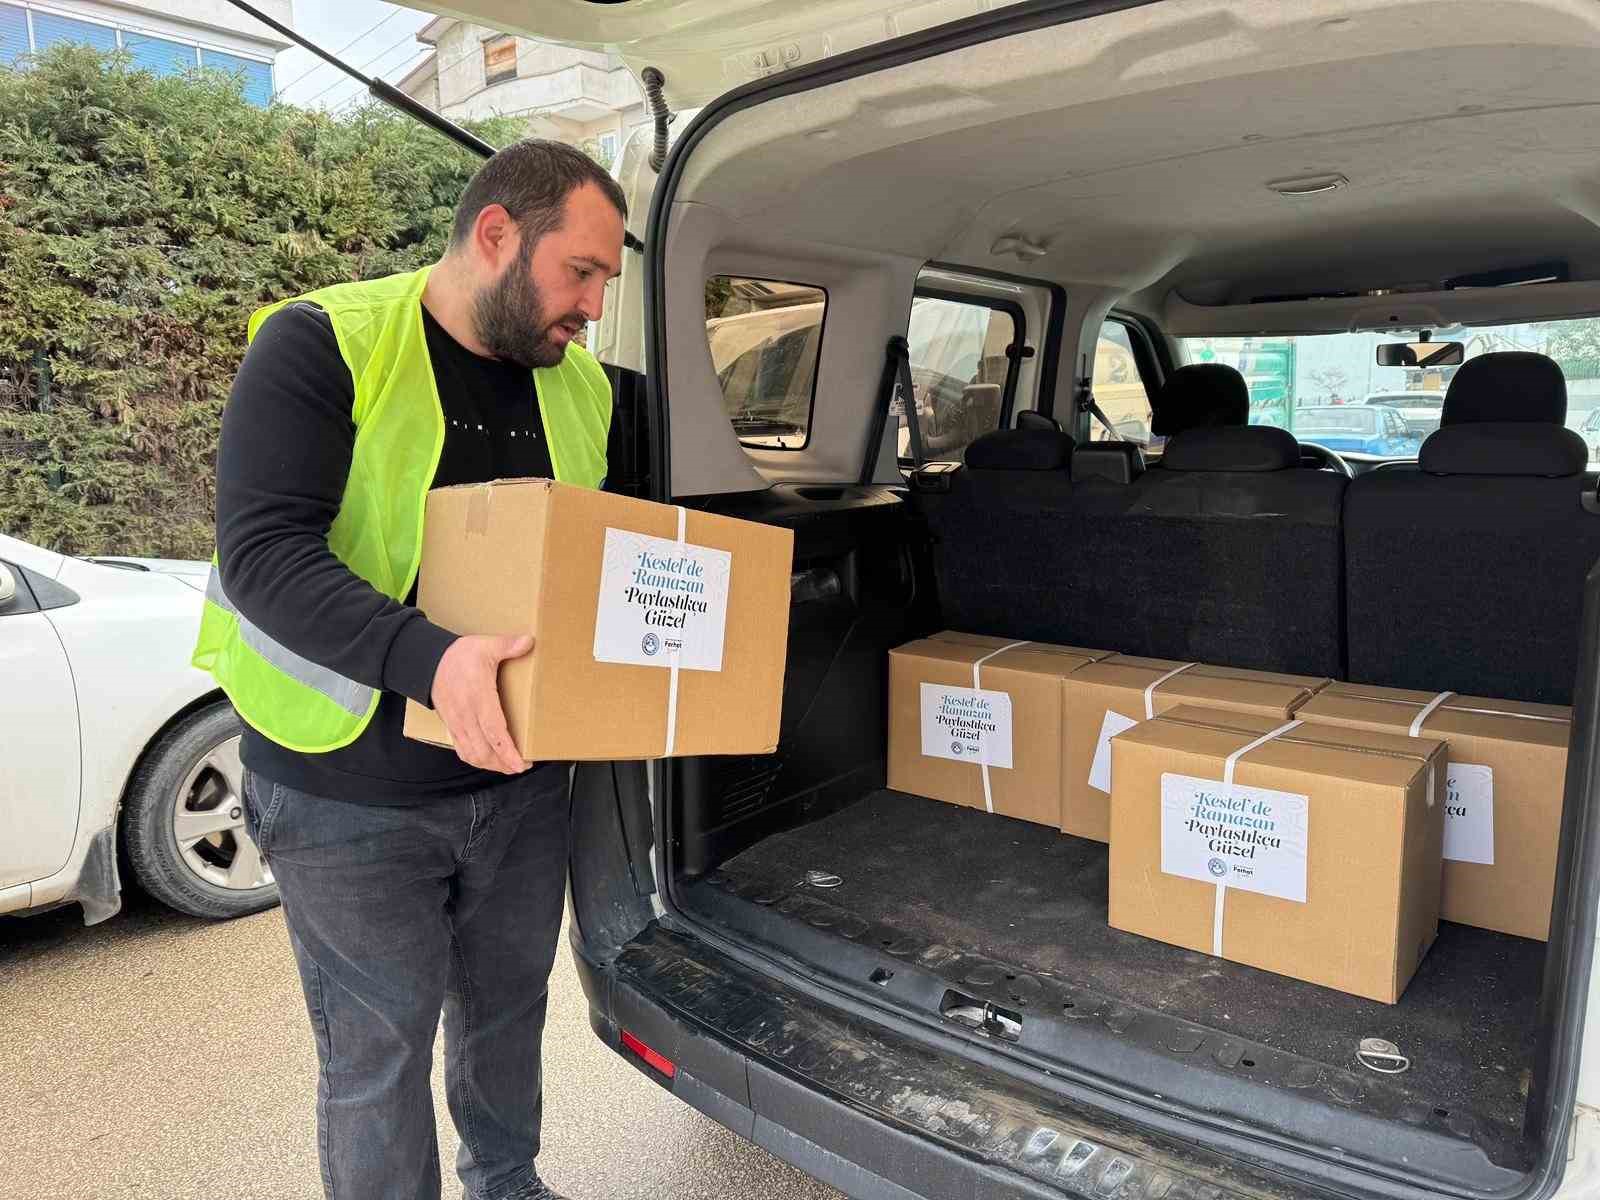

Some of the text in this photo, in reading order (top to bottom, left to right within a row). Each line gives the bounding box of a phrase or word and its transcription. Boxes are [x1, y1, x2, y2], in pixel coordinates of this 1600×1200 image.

[638, 552, 704, 577] Kestel'de
[632, 568, 704, 593] Ramazan
[645, 610, 686, 629] Güzel
[938, 705, 992, 720] Ramazan
[951, 728, 980, 741] Güzel
[1194, 792, 1272, 817] Kestel'de
[1190, 807, 1275, 831] Ramazan
[1208, 839, 1255, 859] Güzel
